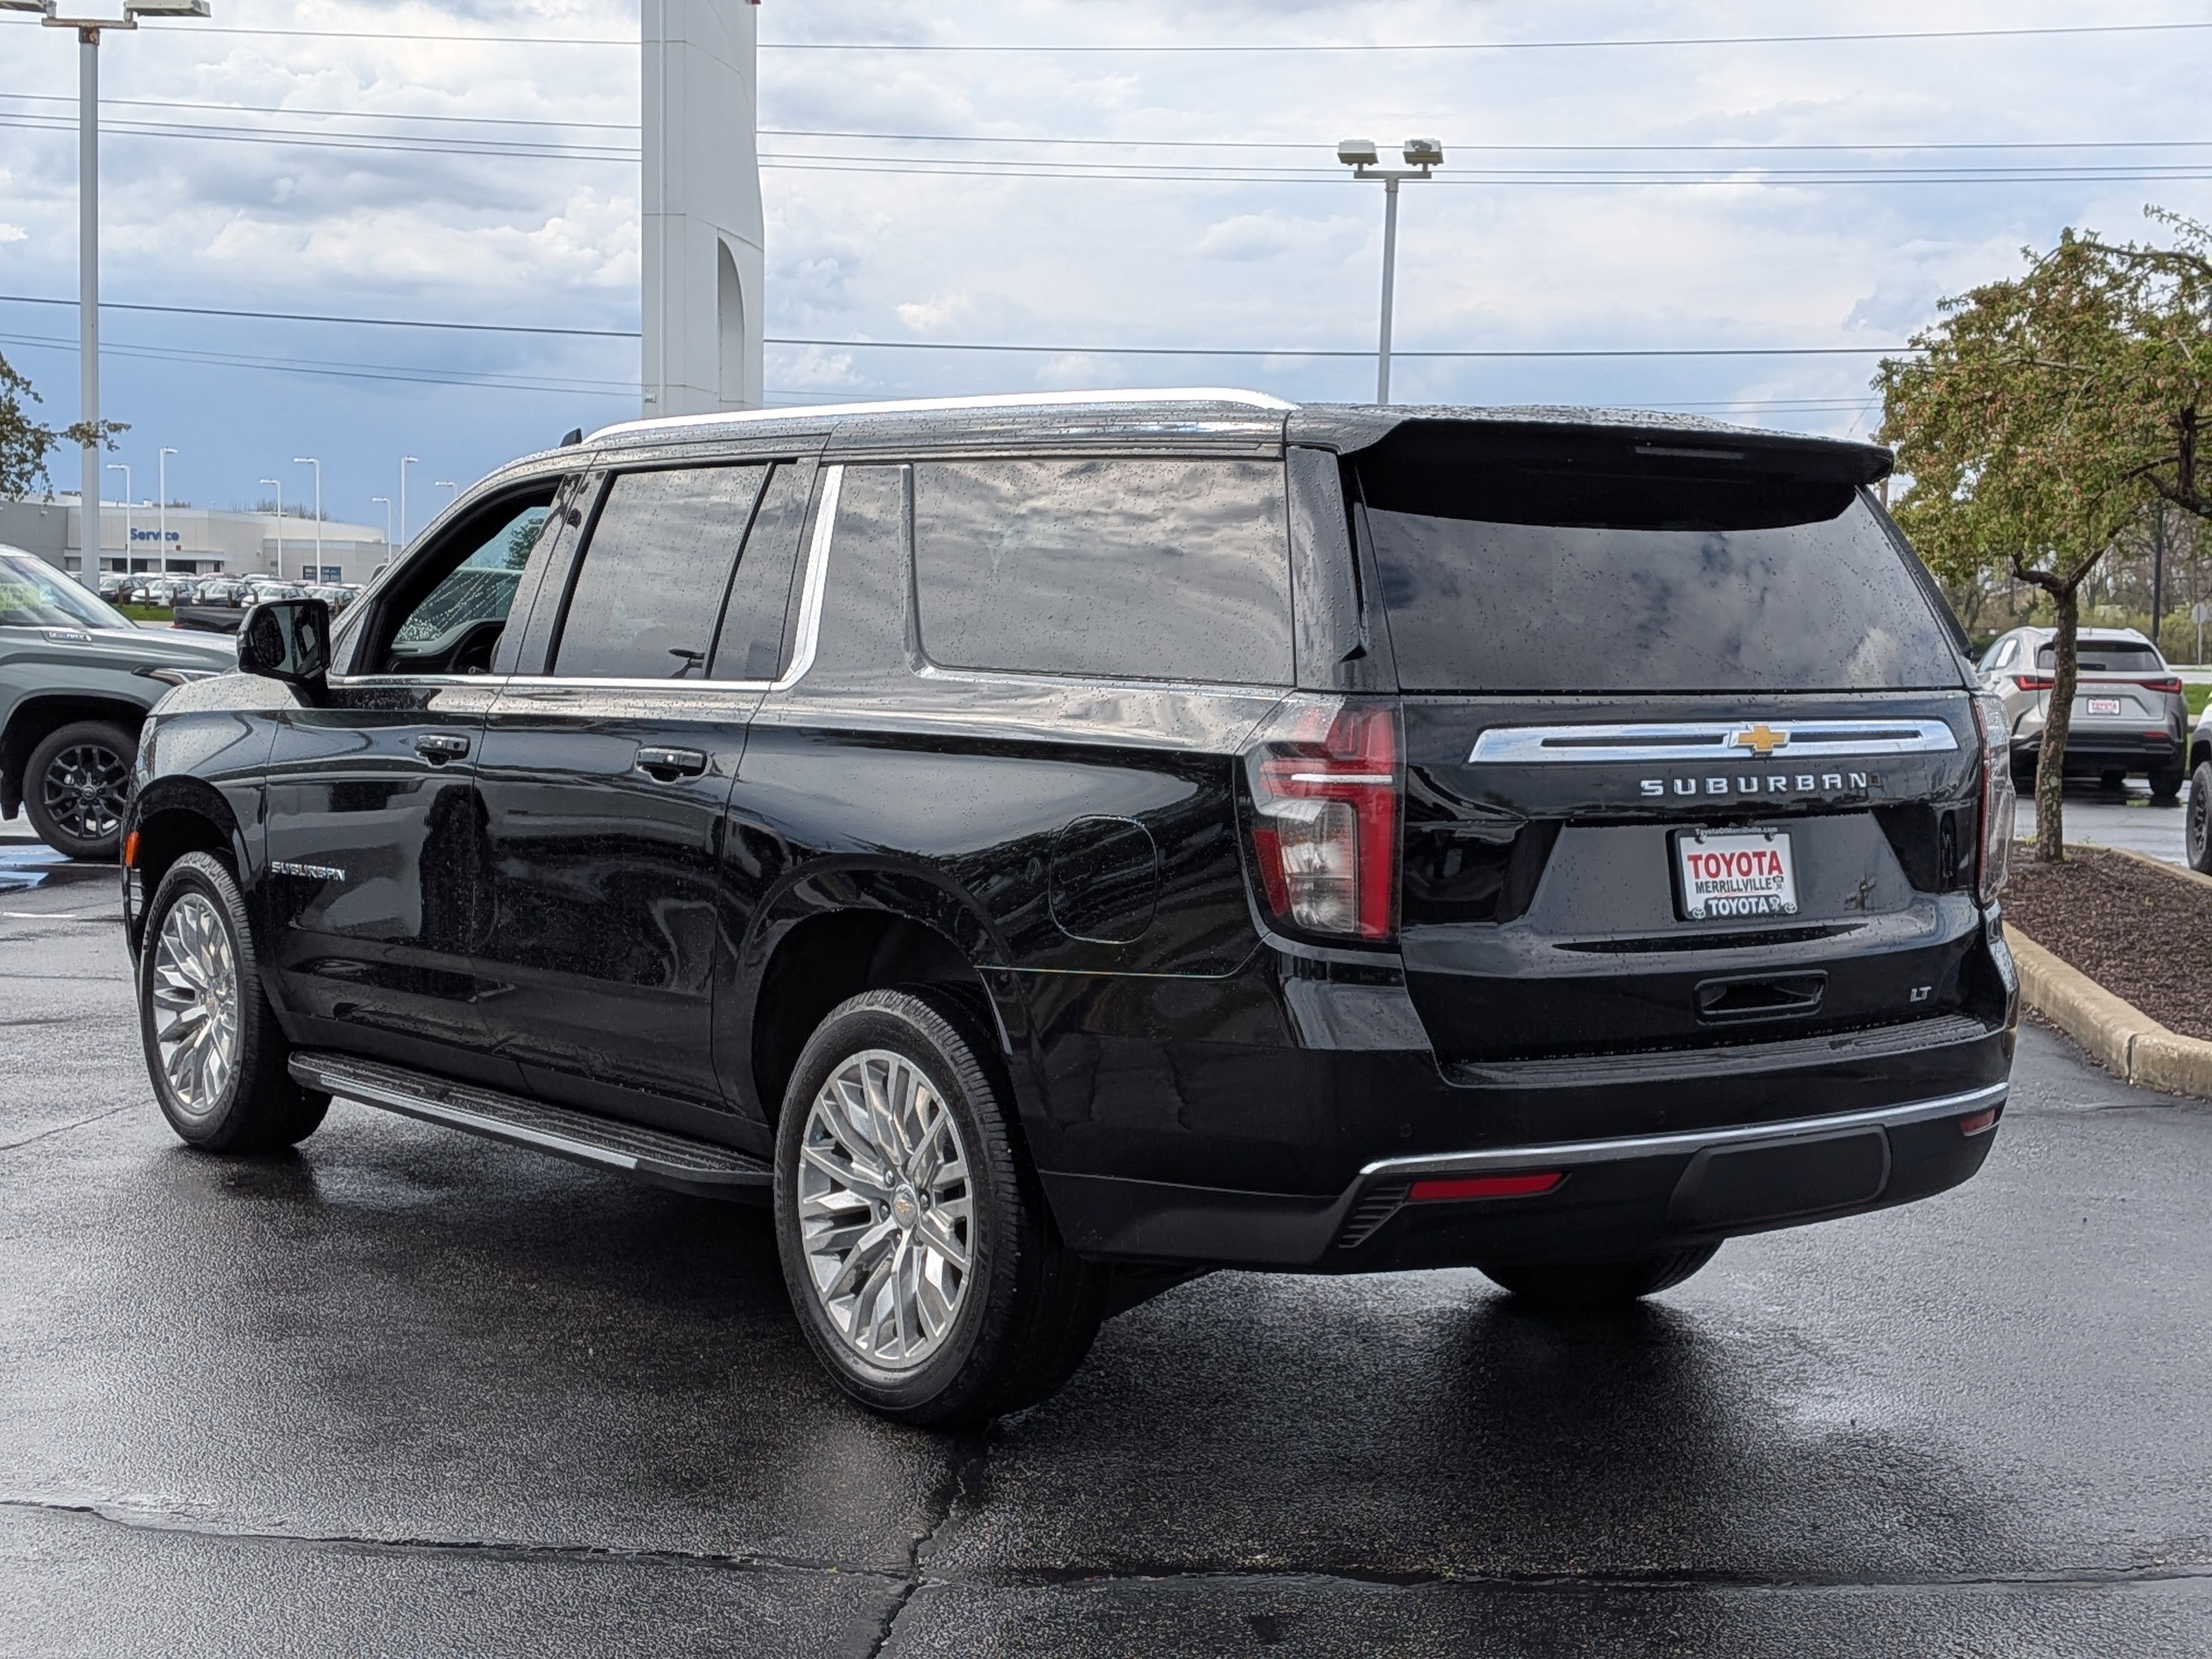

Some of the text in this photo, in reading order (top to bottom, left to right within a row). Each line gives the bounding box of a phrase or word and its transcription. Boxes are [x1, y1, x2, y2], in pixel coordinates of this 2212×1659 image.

[1640, 772, 1867, 796] SUBURBAN
[271, 860, 345, 882] SUBURBAN
[1687, 851, 1783, 879] TOYOTA
[1695, 878, 1773, 894] MERRILLVILLE
[1708, 896, 1770, 916] TOYOTA
[1910, 985, 1932, 1002] LT
